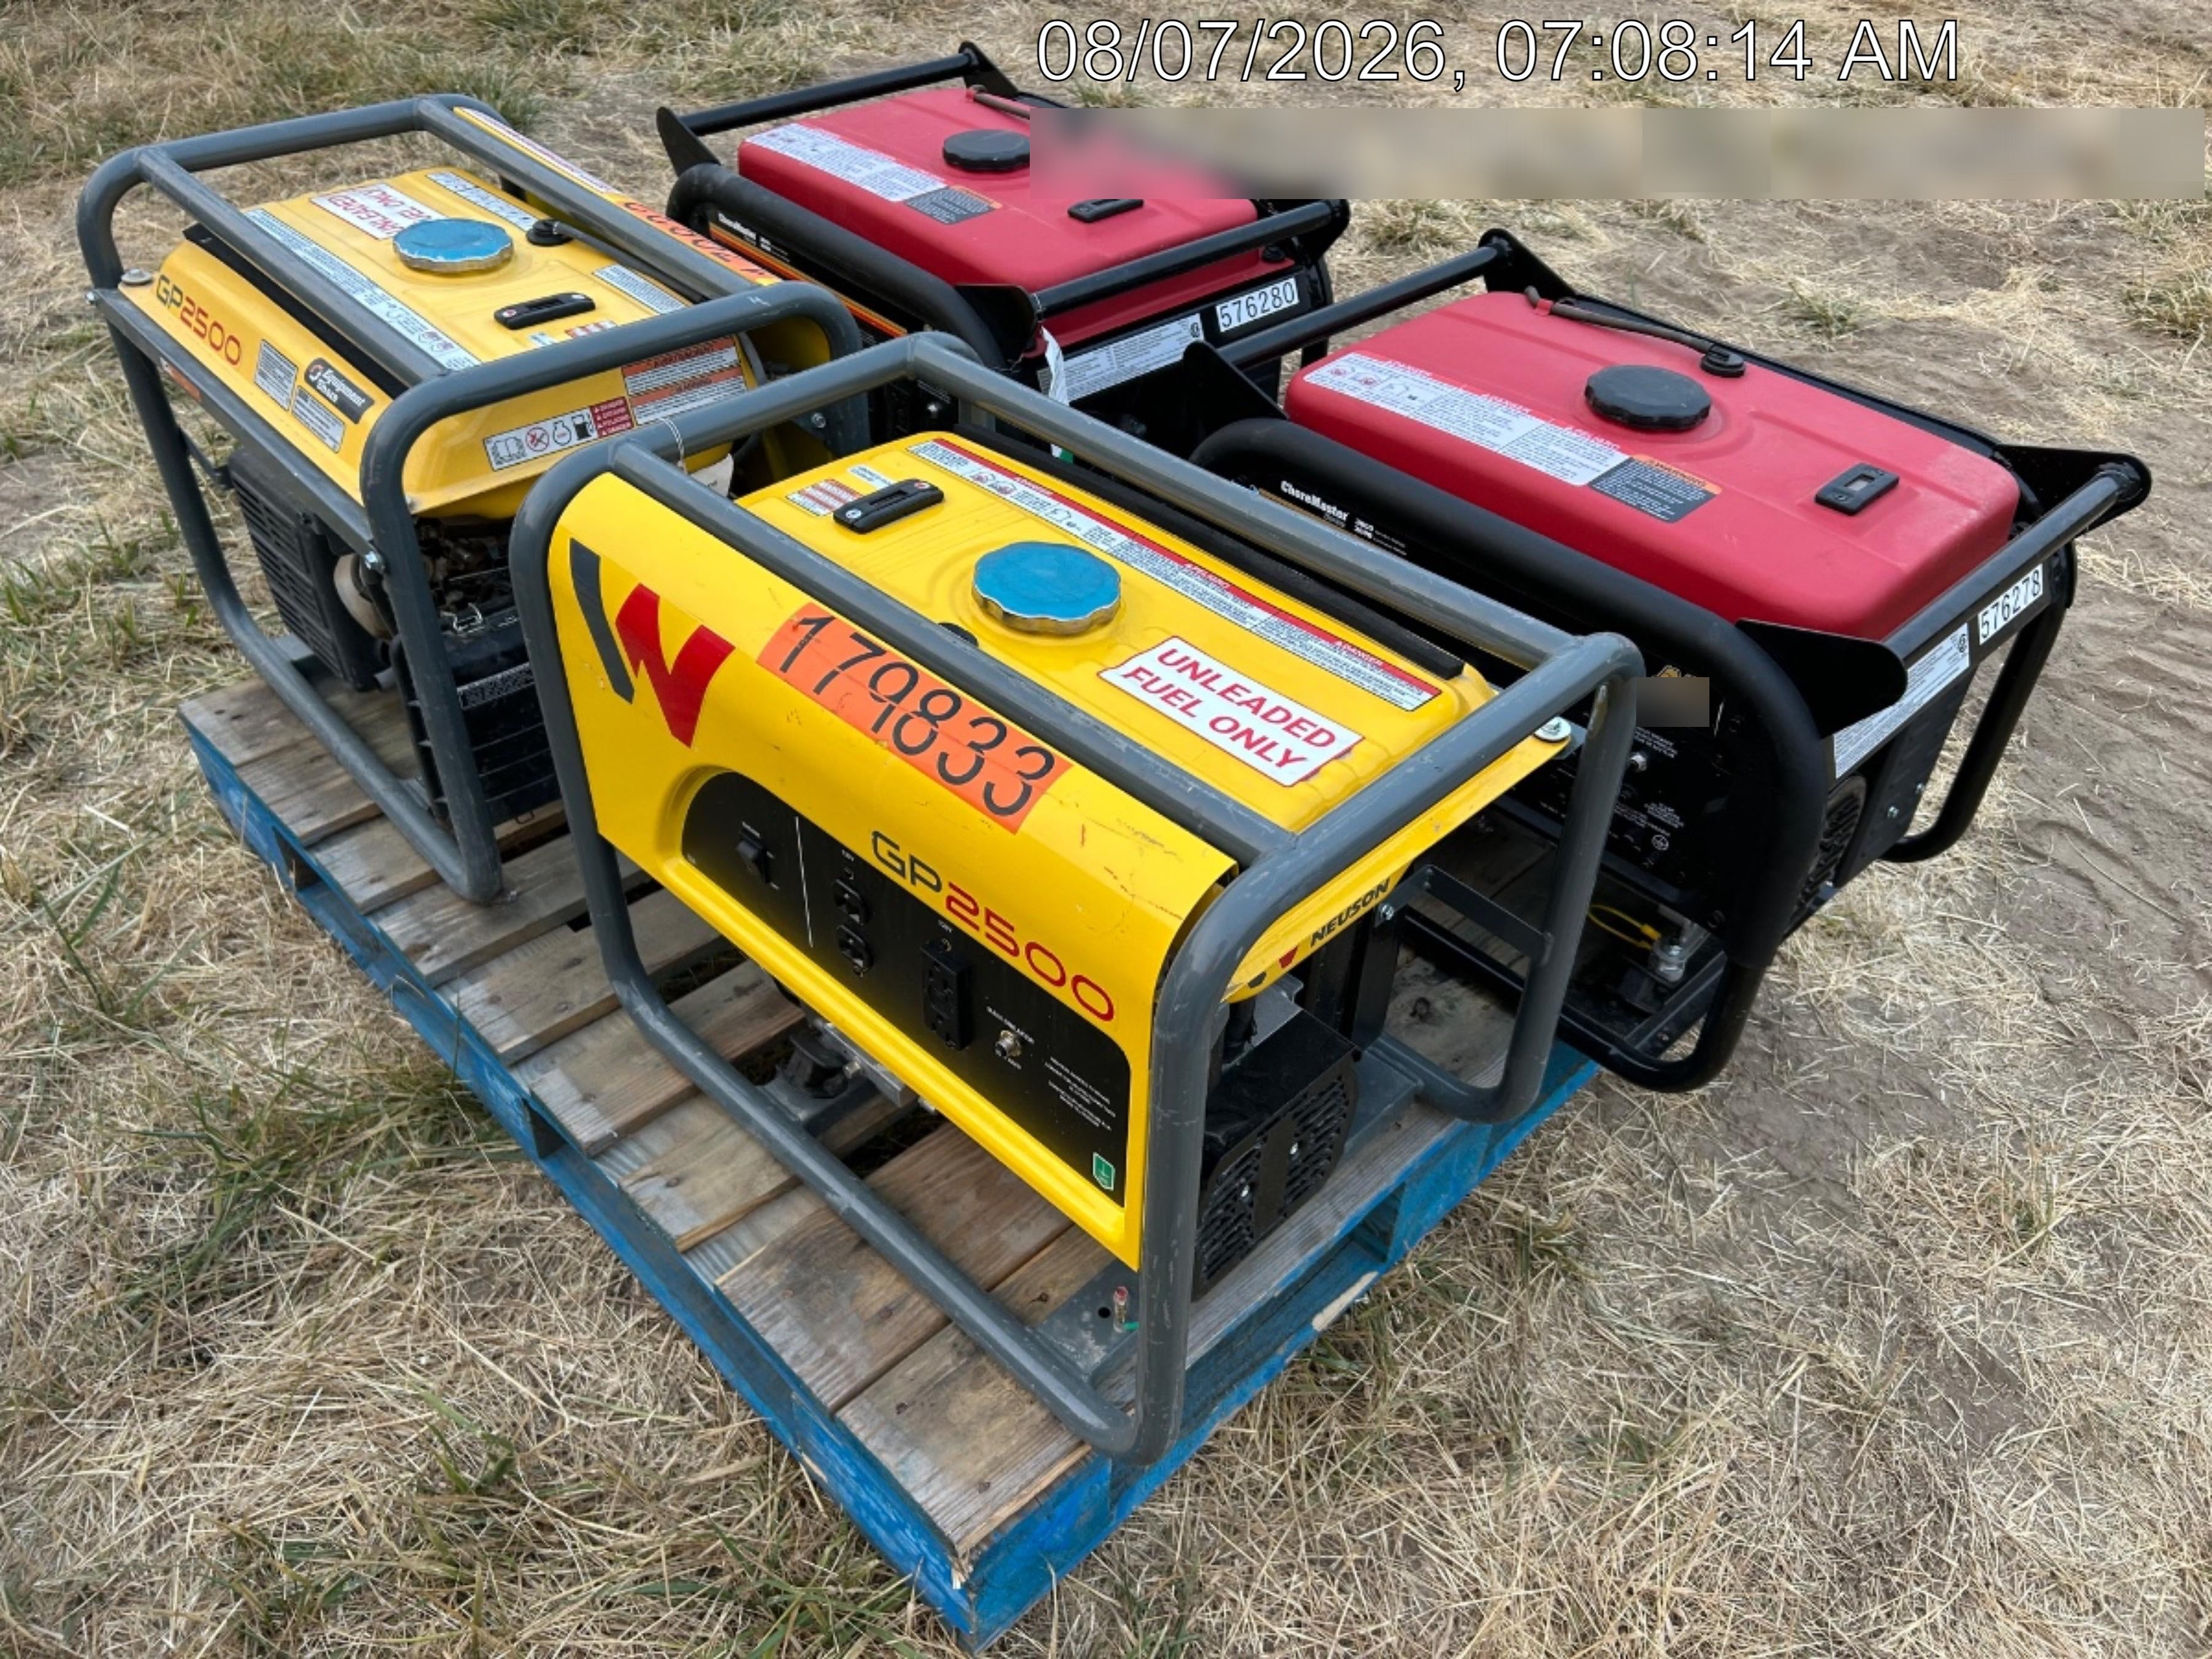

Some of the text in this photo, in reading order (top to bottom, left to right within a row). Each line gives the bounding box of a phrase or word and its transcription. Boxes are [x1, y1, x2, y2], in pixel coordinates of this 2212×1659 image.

[156, 275, 242, 366] GP2500
[1220, 281, 1295, 328] 576280
[1281, 480, 1349, 521] ChoreMaster
[1980, 568, 2041, 639] 576278
[779, 616, 1055, 816] 179833
[1122, 665, 1309, 768] FUEL ONLY
[1156, 648, 1336, 747] UNLEADED
[871, 830, 1115, 1021] GP2500
[1309, 877, 1390, 947] NEUSON
